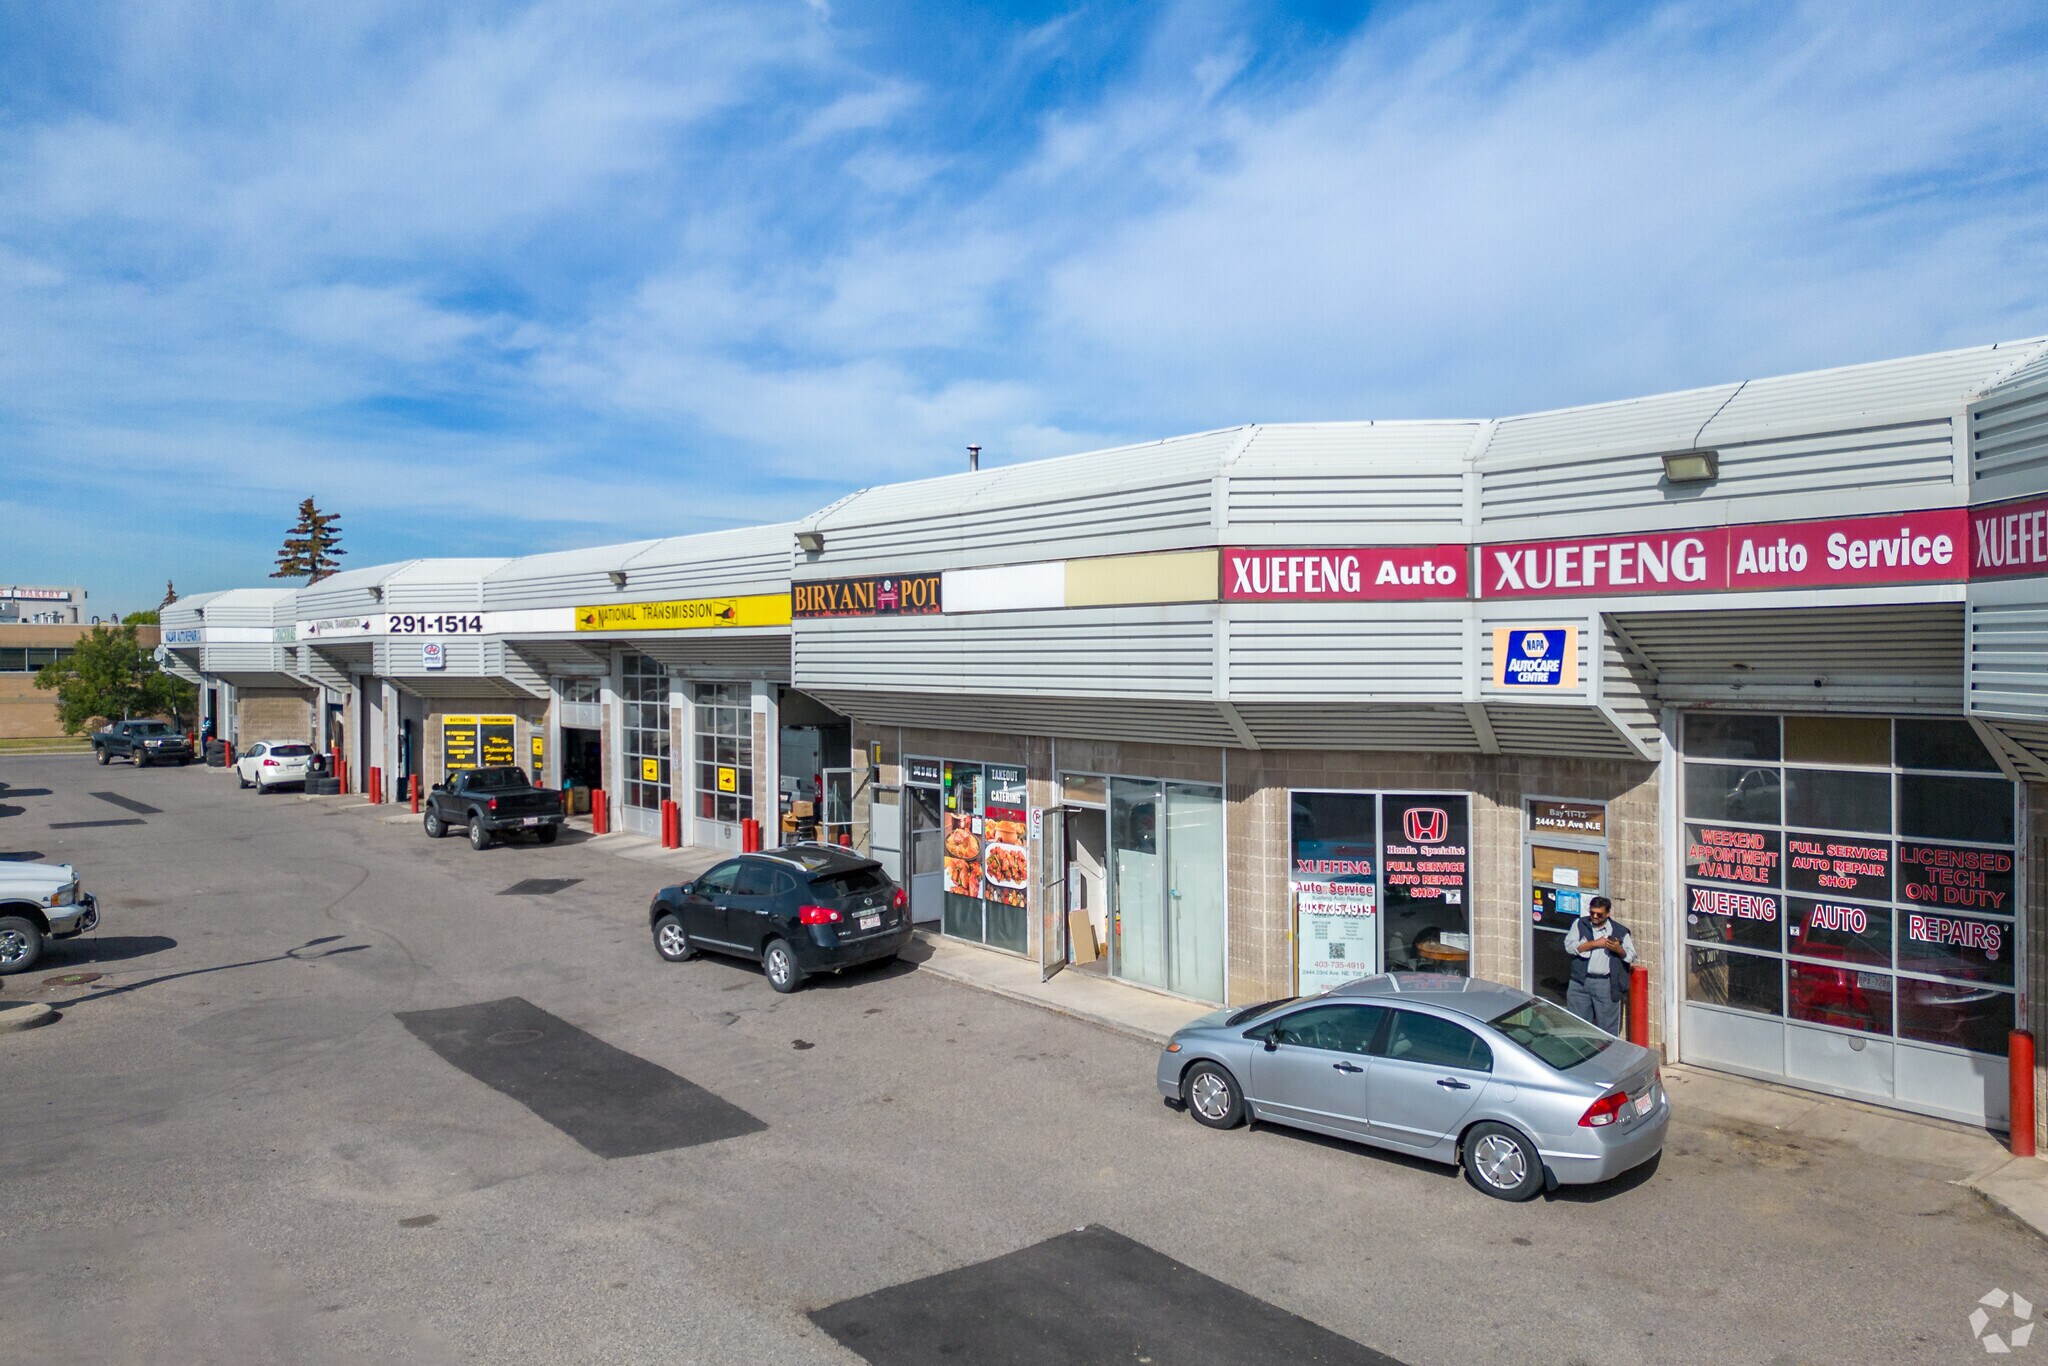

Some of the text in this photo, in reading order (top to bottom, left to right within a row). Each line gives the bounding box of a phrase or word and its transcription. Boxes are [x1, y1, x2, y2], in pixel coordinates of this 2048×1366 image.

[1975, 508, 2048, 568] XUEFE
[1494, 528, 1953, 591] XUEFENG Auto Service
[1232, 556, 1457, 593] XUEFENG Auto
[20, 589, 61, 598] BAKERY
[794, 577, 940, 611] BIRYANI POT
[389, 615, 483, 633] 291-1514
[598, 603, 712, 628] NATIONAL TRANSMISSION
[1526, 639, 1545, 651] NAPA
[1517, 672, 1549, 682] CENTRE
[992, 769, 1018, 782] TAKEOUT
[1003, 781, 1009, 792] &
[991, 790, 1021, 804] CATERING
[1549, 808, 1564, 818] Bay
[1535, 817, 1554, 826] 2444
[1556, 819, 1566, 827] 23
[1568, 821, 1584, 829] Ave
[1701, 829, 1765, 850] WEEKEND
[1387, 845, 1466, 857] Honda Specialist
[1689, 844, 1779, 867] APPOINTMENT
[1789, 841, 1888, 861] FULL SERVICE
[1900, 846, 2011, 872] LICENSED
[1297, 859, 1371, 876] XUEFENG
[1387, 861, 1465, 873] FULL SERVICE
[1698, 861, 1769, 883] AVAILABLE
[1792, 856, 1885, 877] AUTO REPAIR
[1389, 874, 1463, 886] AUTO REPAIR
[1818, 874, 1857, 889] SHOP
[1925, 866, 1985, 889] TECH
[1296, 881, 1373, 896] Auto Service
[1410, 887, 1441, 898] SHOP
[1905, 883, 2006, 909] ON DUTY
[1692, 888, 1776, 922] XUEFENG
[1811, 904, 1867, 934] AUTO
[1909, 914, 2001, 951] REPAIRS
[1314, 960, 1365, 969] 403-735-4919
